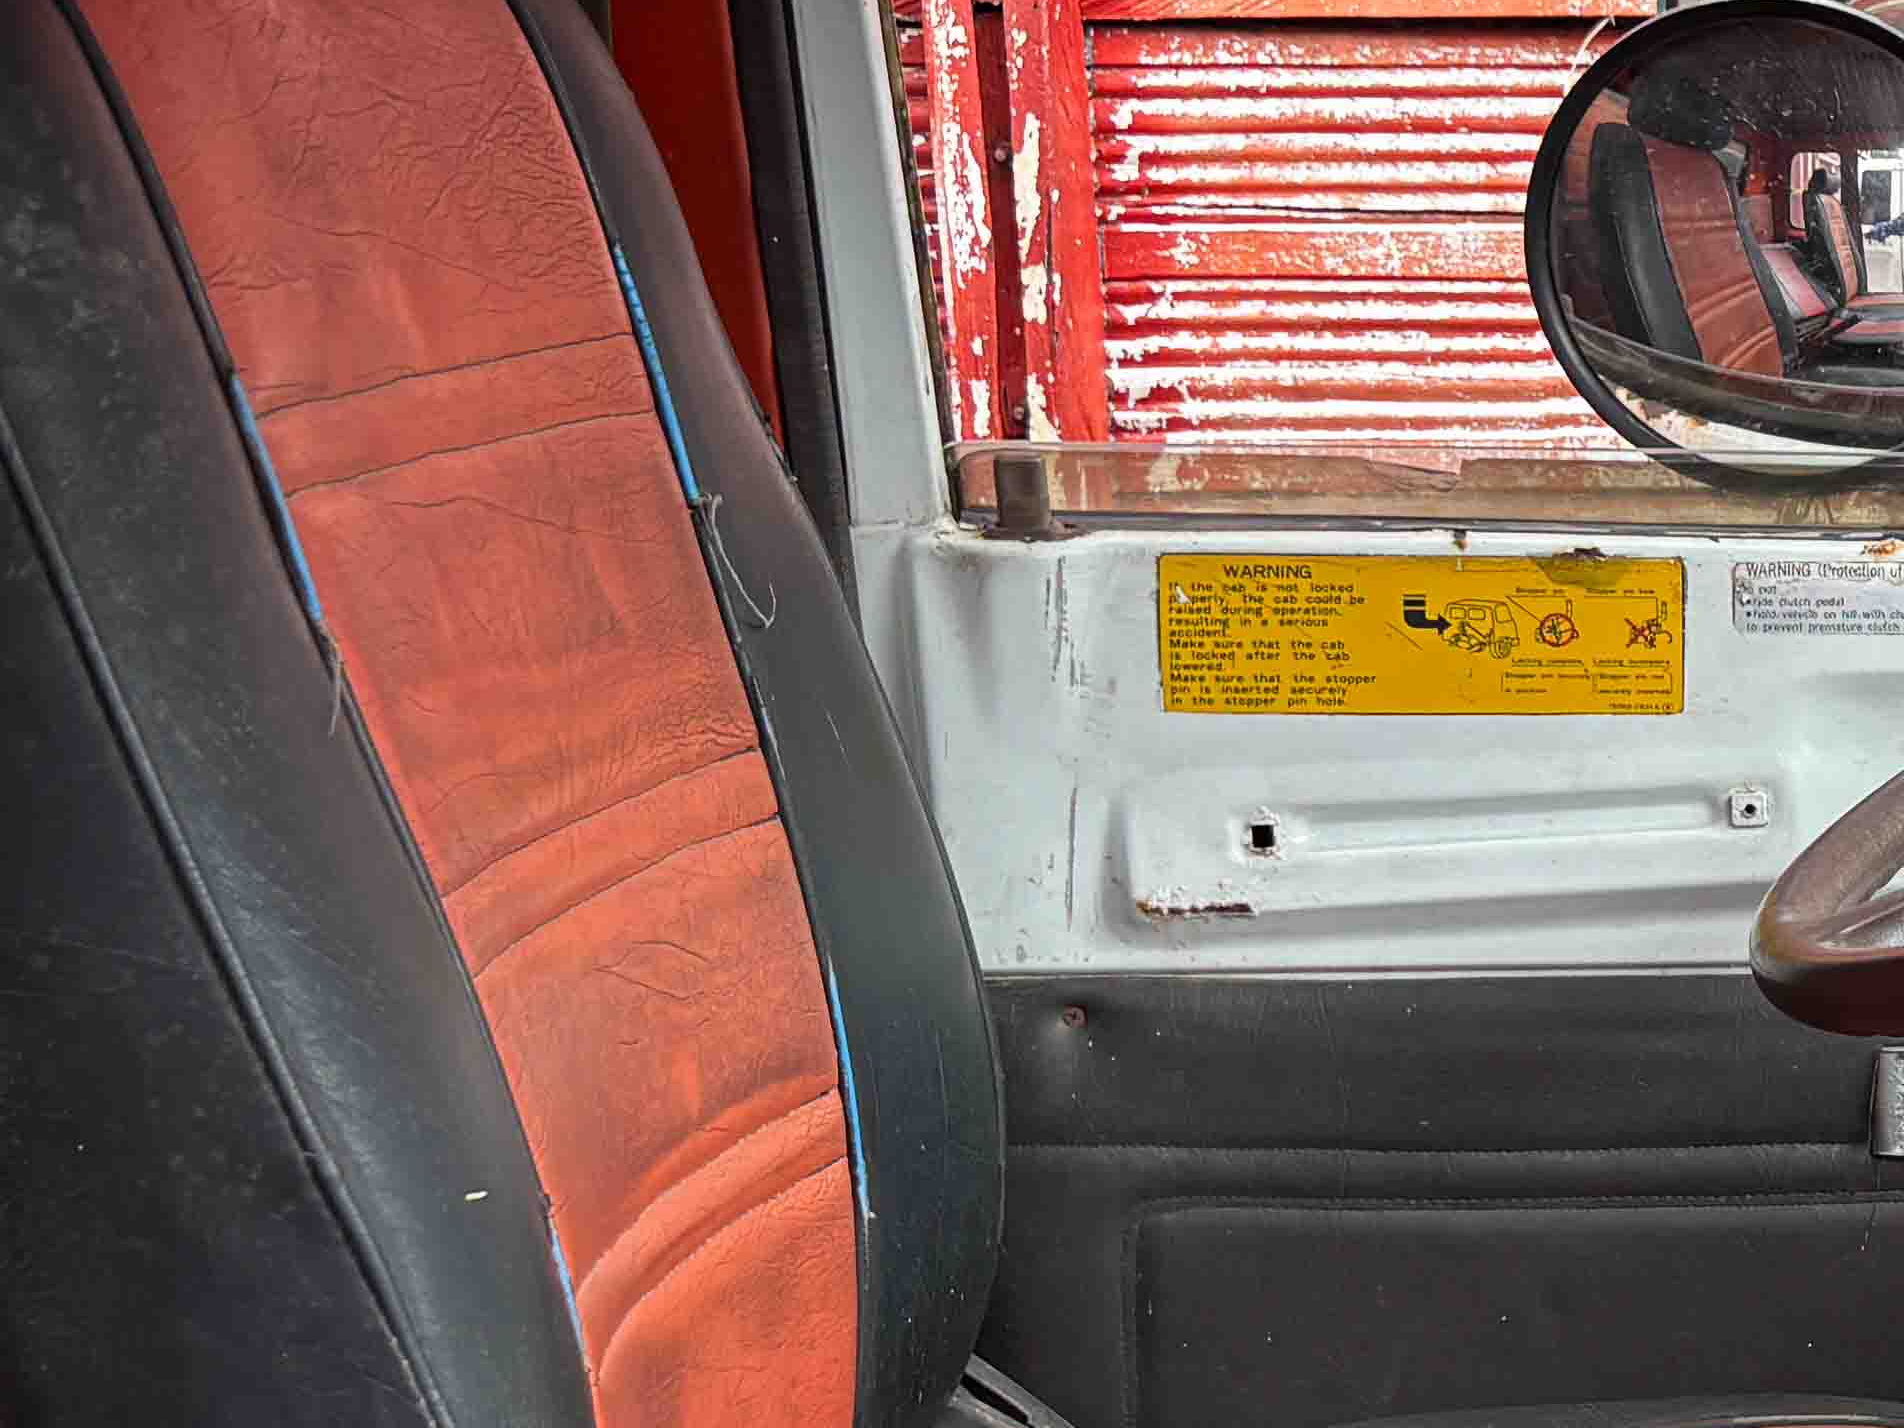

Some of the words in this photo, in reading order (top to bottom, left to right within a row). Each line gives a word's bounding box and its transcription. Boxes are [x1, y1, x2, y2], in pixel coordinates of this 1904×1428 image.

[1222, 563, 1313, 580] WARNING
[1746, 562, 1811, 578] WARNING
[1818, 562, 1886, 579] (Protection
[1191, 582, 1213, 592] the
[1222, 582, 1245, 592] cab
[1256, 582, 1268, 592] is
[1276, 582, 1299, 592] not
[1310, 582, 1354, 593] locked
[1242, 594, 1265, 604] the
[1273, 594, 1298, 604] cab
[1305, 594, 1341, 605] could
[1347, 595, 1366, 605] be
[1778, 596, 1811, 606] clutch
[1815, 597, 1845, 608] pedal
[1168, 606, 1212, 615] raised
[1222, 606, 1264, 618] during
[1823, 611, 1837, 619] on
[1861, 609, 1886, 619] with
[1168, 617, 1230, 629] resulting
[1239, 617, 1251, 627] in
[1260, 619, 1270, 627] a
[1278, 618, 1329, 627] serious
[1746, 622, 1758, 632] to
[1763, 622, 1803, 634] prevent
[1808, 622, 1862, 634] premature
[1866, 622, 1901, 632] clutch
[1168, 640, 1206, 649] Make
[1213, 641, 1244, 649] sure
[1251, 640, 1281, 649] that
[1290, 640, 1313, 649] the
[1319, 640, 1345, 649] cab
[1169, 651, 1182, 660] is
[1191, 651, 1236, 661] locked
[1245, 651, 1281, 661] after
[1293, 651, 1316, 661] the
[1324, 652, 1351, 661] cab
[1169, 674, 1207, 683] Make
[1214, 675, 1246, 683] sure
[1253, 674, 1282, 683] that
[1293, 674, 1316, 683] the
[1324, 674, 1377, 687] stopper
[1169, 685, 1191, 696] pin
[1199, 685, 1211, 694] is
[1221, 685, 1281, 694] inserted
[1289, 685, 1348, 697] securely
[1169, 696, 1184, 706] in
[1192, 697, 1216, 706] the
[1223, 697, 1277, 709] stopper
[1287, 697, 1309, 709] pin
